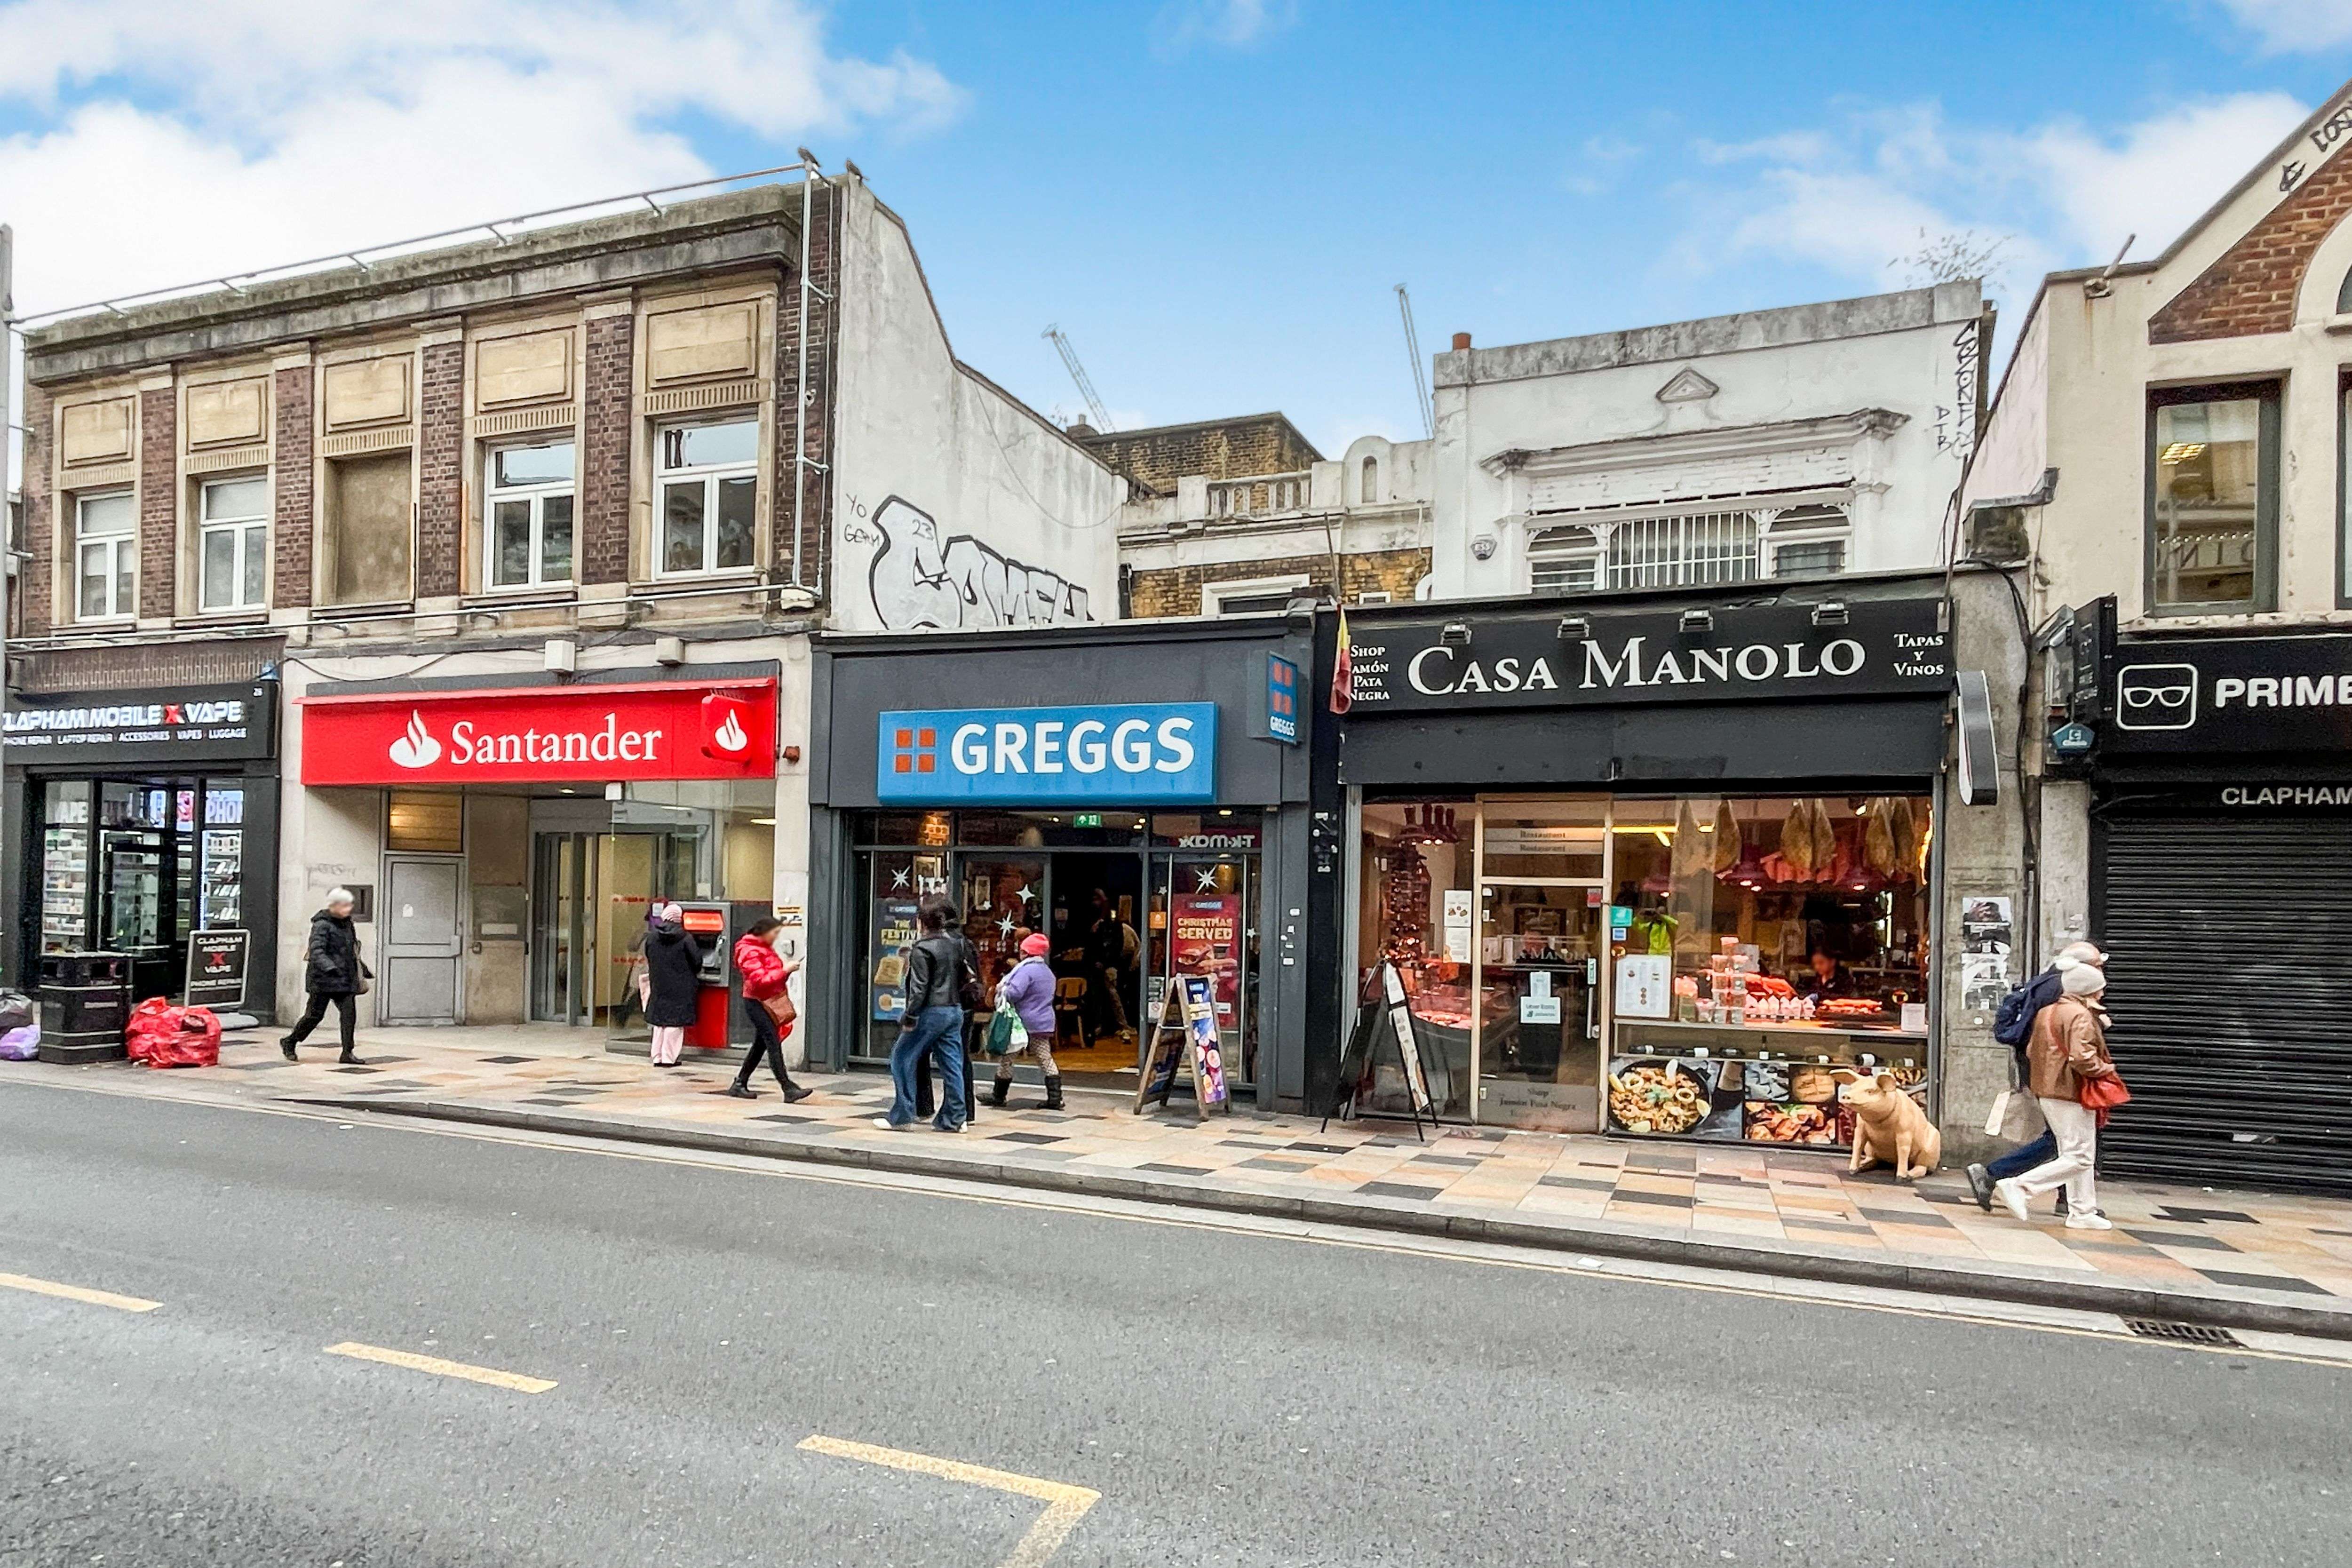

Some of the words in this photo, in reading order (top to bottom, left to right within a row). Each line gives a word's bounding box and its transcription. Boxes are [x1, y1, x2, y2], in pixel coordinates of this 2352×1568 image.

[2215, 675, 2352, 708] PRIME
[90, 705, 162, 729] MOBILE
[165, 705, 185, 725] X
[184, 700, 242, 724] VAPE
[1270, 716, 1295, 737] GREGGS
[450, 712, 662, 765] Santander
[951, 716, 1195, 775] GREGGS
[1177, 918, 1232, 927] CHRISTMAS
[1177, 927, 1232, 940] SERVED
